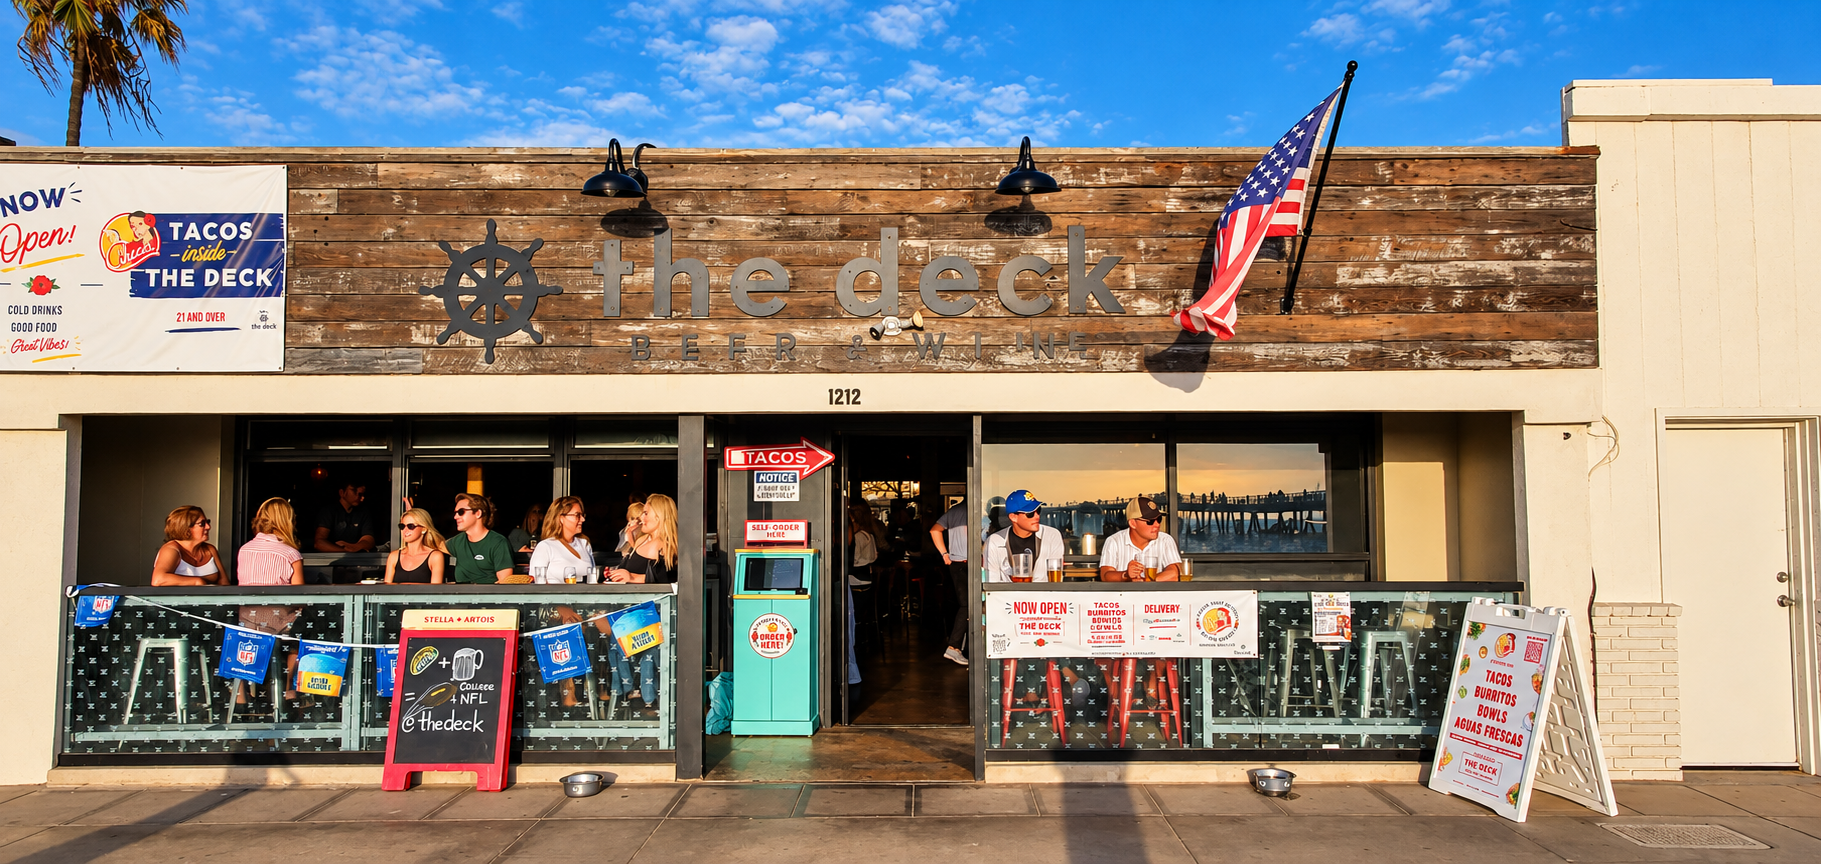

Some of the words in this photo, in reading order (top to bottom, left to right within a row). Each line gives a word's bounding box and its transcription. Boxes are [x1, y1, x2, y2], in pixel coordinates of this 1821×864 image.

[0, 187, 66, 218] NOW
[169, 221, 253, 241] TACOS
[0, 222, 77, 265] Open!
[181, 240, 227, 263] inside
[145, 268, 195, 287] THE
[203, 268, 273, 287] DECK
[593, 227, 790, 318] the
[835, 225, 1126, 317] deck
[8, 305, 29, 316] COLD
[32, 305, 63, 316] DRINKS
[176, 312, 185, 323] 21
[186, 312, 204, 323] AND
[205, 312, 226, 322] OVER
[11, 322, 33, 333] GOOD
[36, 322, 57, 333] FOOD
[845, 334, 868, 360] &
[828, 387, 861, 406] 1212
[746, 451, 807, 464] TACOS
[1013, 601, 1038, 615] NOW
[1040, 601, 1067, 615] OPEN
[1144, 604, 1180, 614] DELIVERY
[1019, 622, 1036, 630] THE
[1038, 622, 1061, 630] DECK
[1485, 669, 1513, 687] TACOS
[460, 692, 488, 705] NFL
[1474, 685, 1517, 707] BURRITOS
[1476, 703, 1508, 724] BOWLS
[1454, 716, 1482, 735] AGUAS
[1483, 724, 1524, 748] FRESCAS
[1464, 758, 1478, 770] THE
